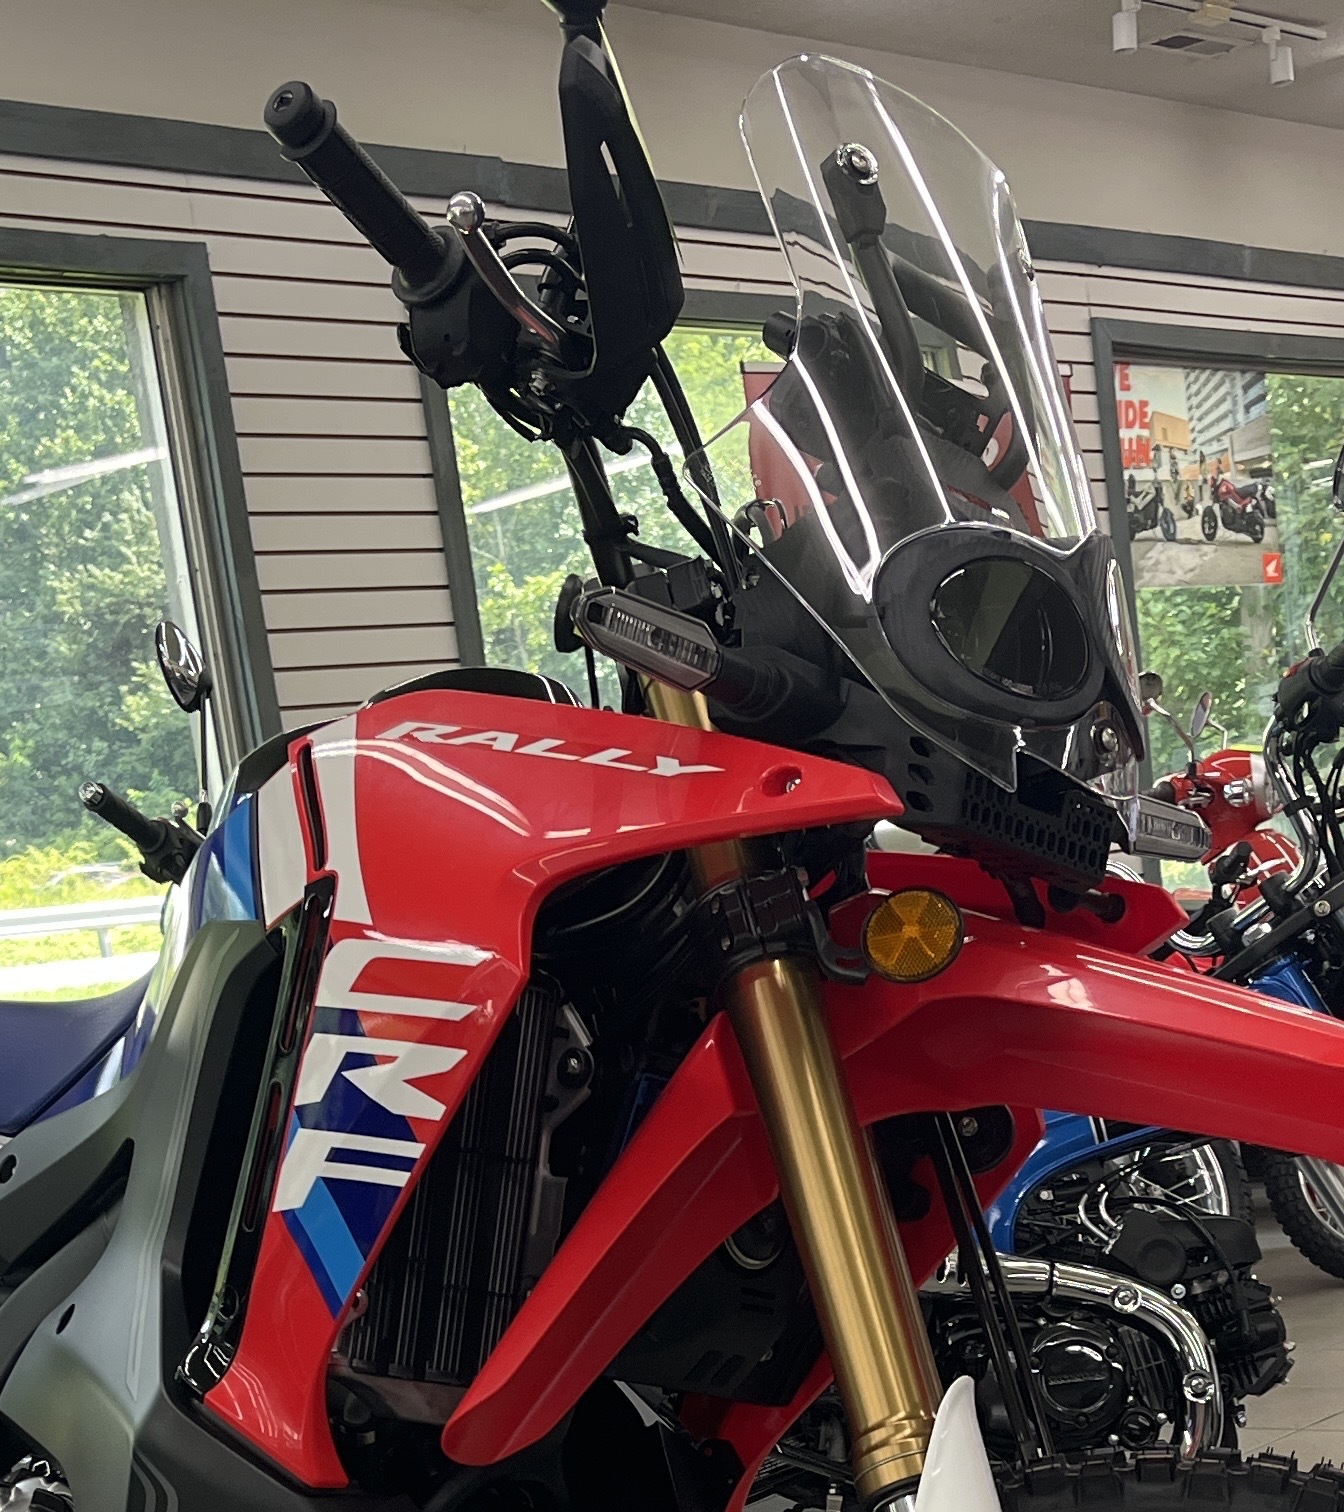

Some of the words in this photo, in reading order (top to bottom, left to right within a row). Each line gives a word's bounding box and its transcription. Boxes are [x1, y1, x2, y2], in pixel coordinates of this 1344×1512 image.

[1117, 400, 1151, 429] IDE
[375, 721, 726, 777] RALLY
[272, 937, 498, 1212] CRF
